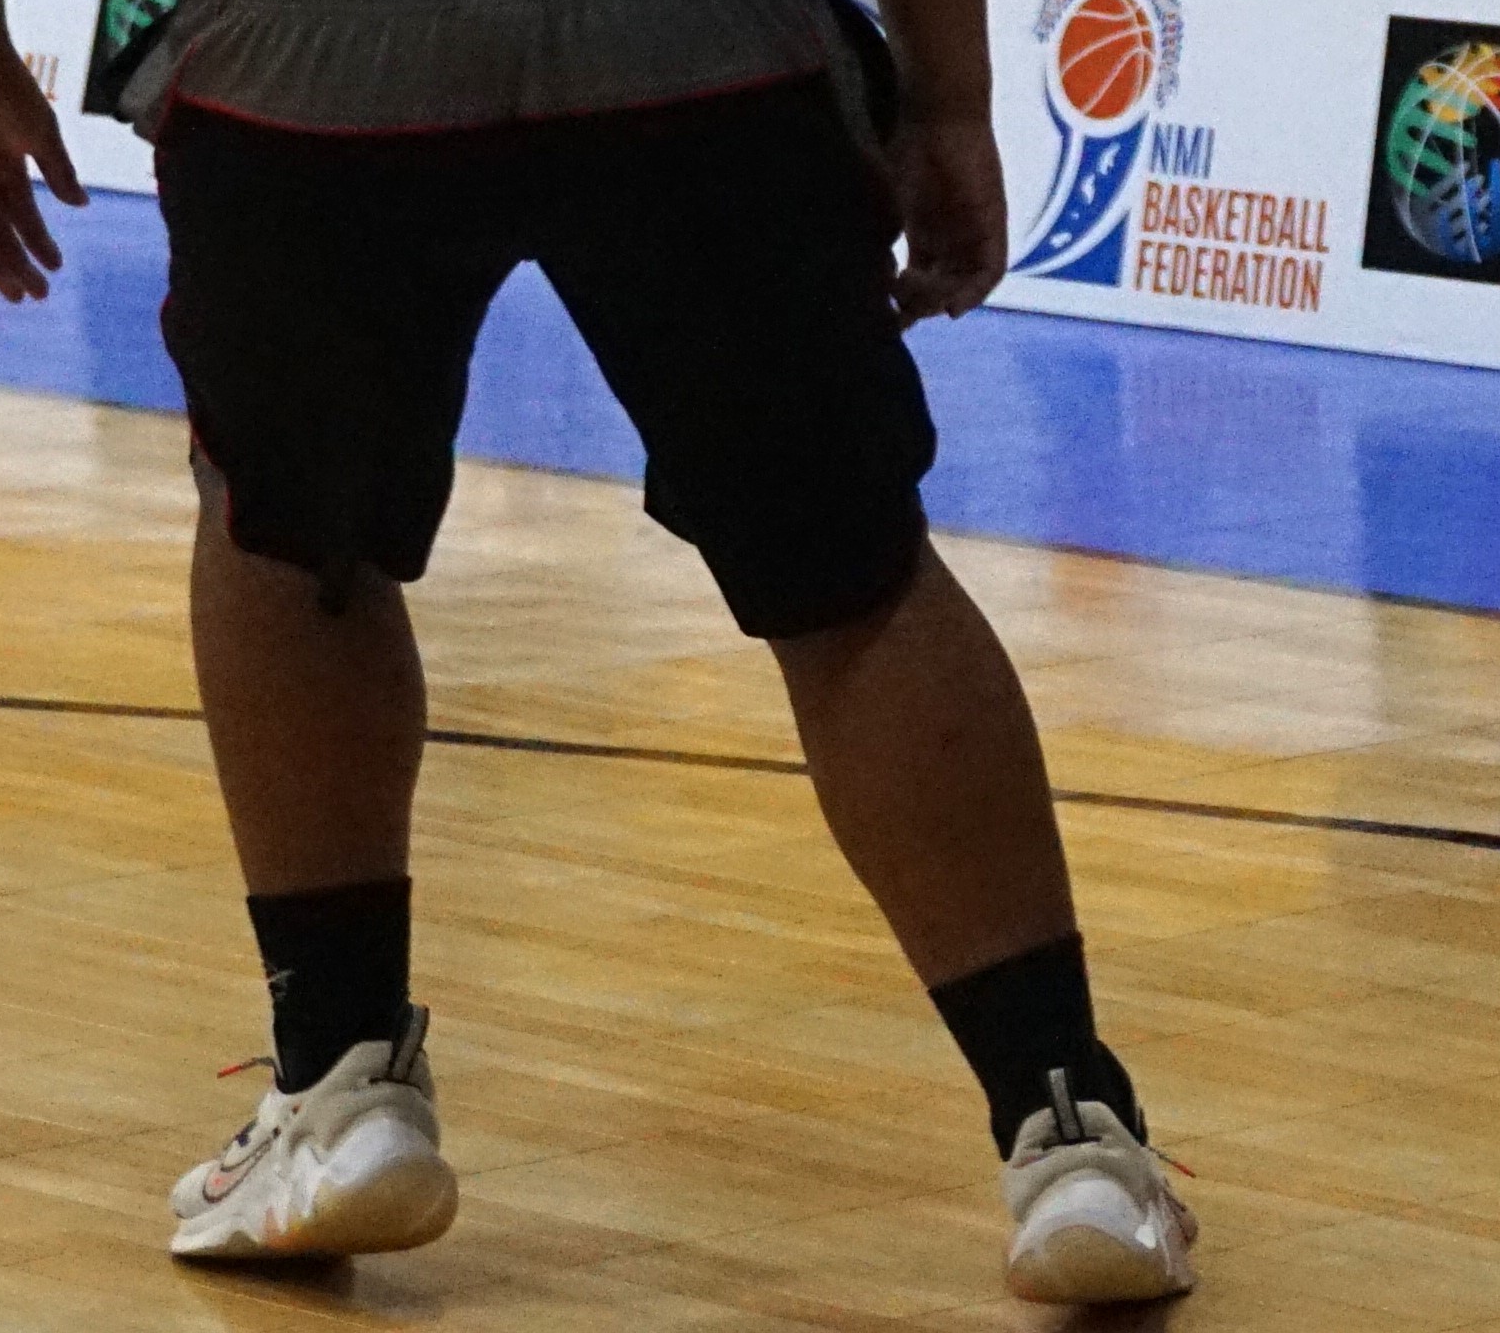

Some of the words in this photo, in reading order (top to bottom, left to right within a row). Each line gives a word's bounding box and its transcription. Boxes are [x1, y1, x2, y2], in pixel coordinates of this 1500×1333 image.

[1149, 122, 1215, 180] NMI
[1141, 180, 1330, 254] BASKETBALL
[1133, 239, 1323, 313] FEDERATION
